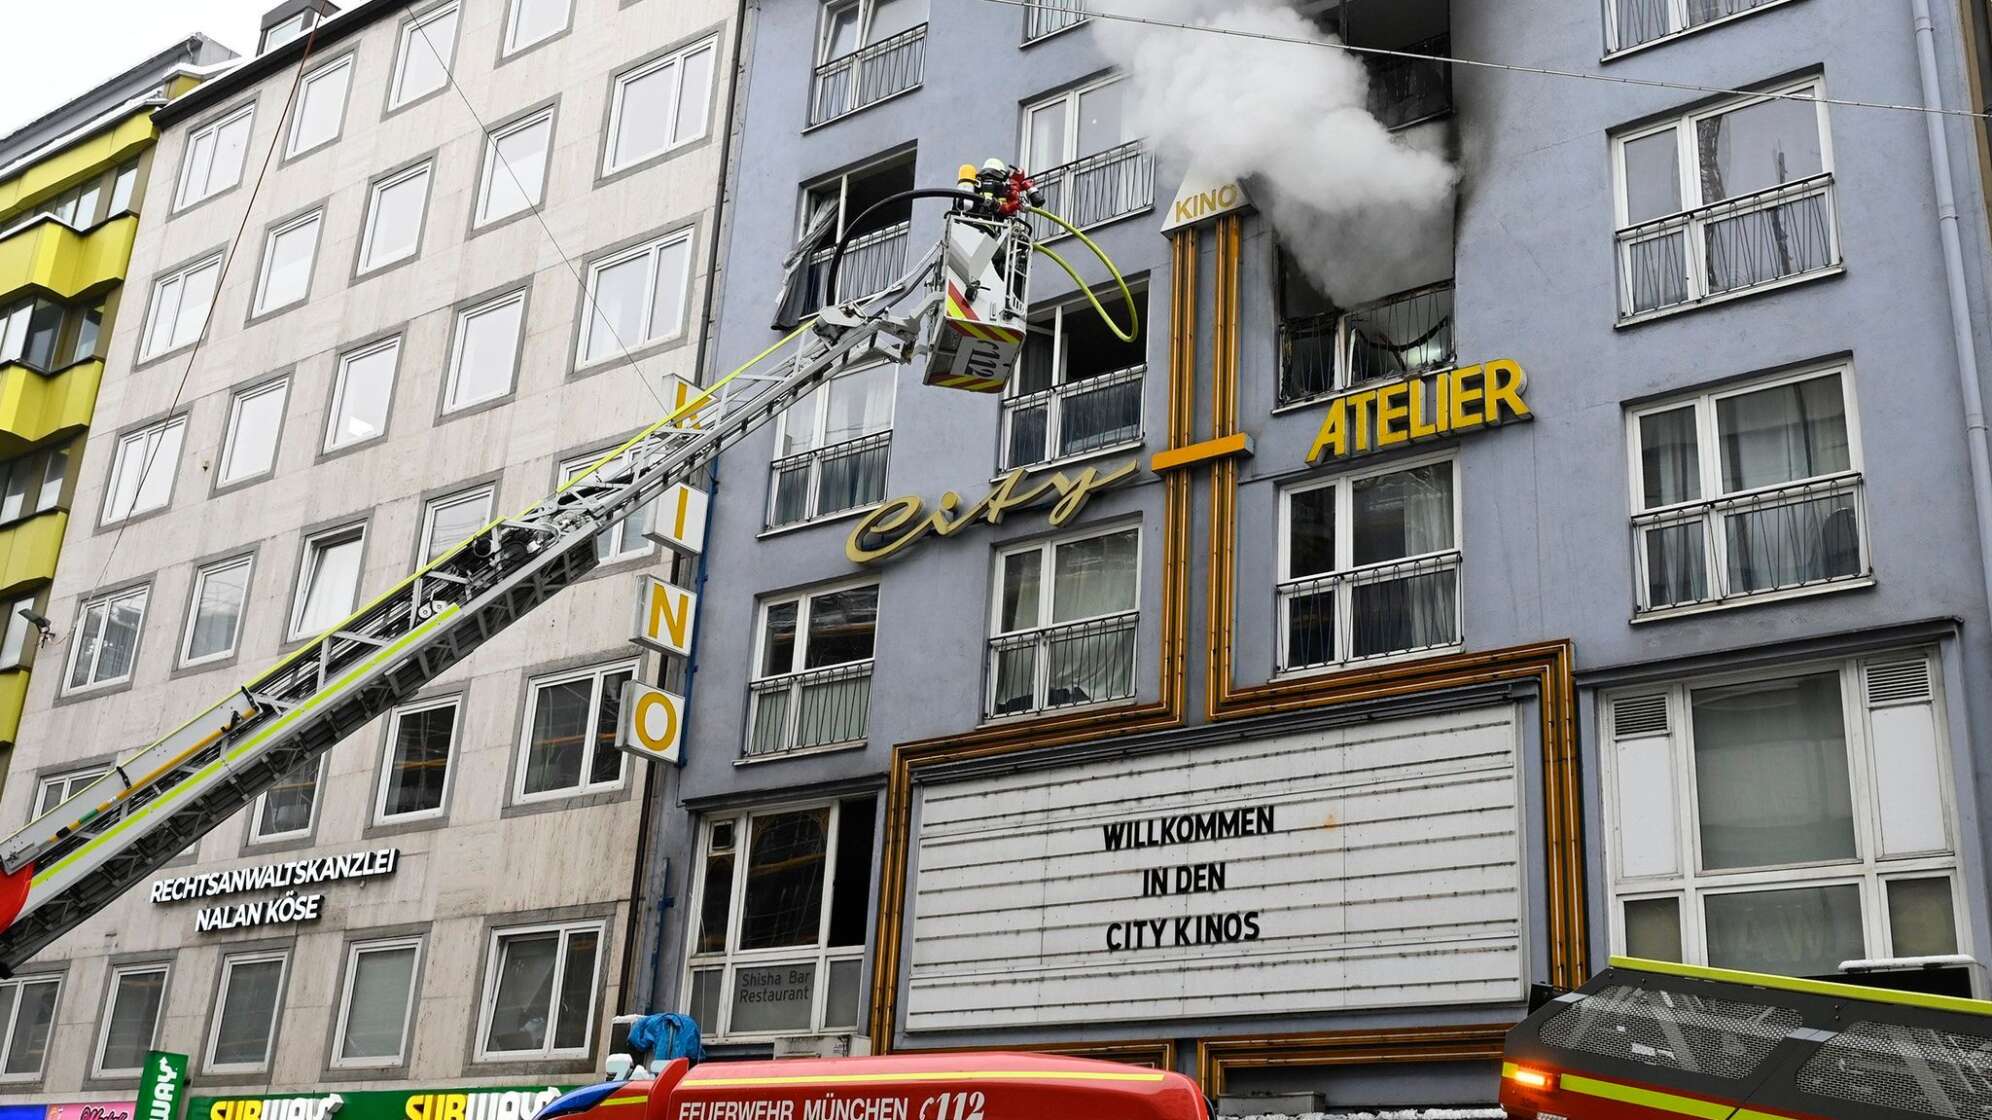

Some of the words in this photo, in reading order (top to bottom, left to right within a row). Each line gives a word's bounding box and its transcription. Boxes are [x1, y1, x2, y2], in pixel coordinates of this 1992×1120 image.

[1175, 184, 1238, 223] KINO
[1304, 358, 1532, 465] ATELIER
[845, 458, 1141, 563] City
[1103, 805, 1274, 851] WILLKOMMEN
[150, 848, 398, 903] RECHTSANWALTSKANZLEI
[1143, 867, 1168, 897] IN
[1175, 862, 1226, 895] DEN
[195, 903, 263, 932] NALAN
[265, 890, 322, 924] KÖSE
[1106, 918, 1168, 950] CITY
[1174, 911, 1261, 947] KINOS
[740, 986, 809, 1003] Restaurant
[742, 973, 781, 987] Shisha
[788, 970, 811, 984] Bar
[679, 1100, 795, 1120] FEUERWEHR
[803, 1092, 909, 1120] MÜNCHEN
[936, 1091, 986, 1120] 112
